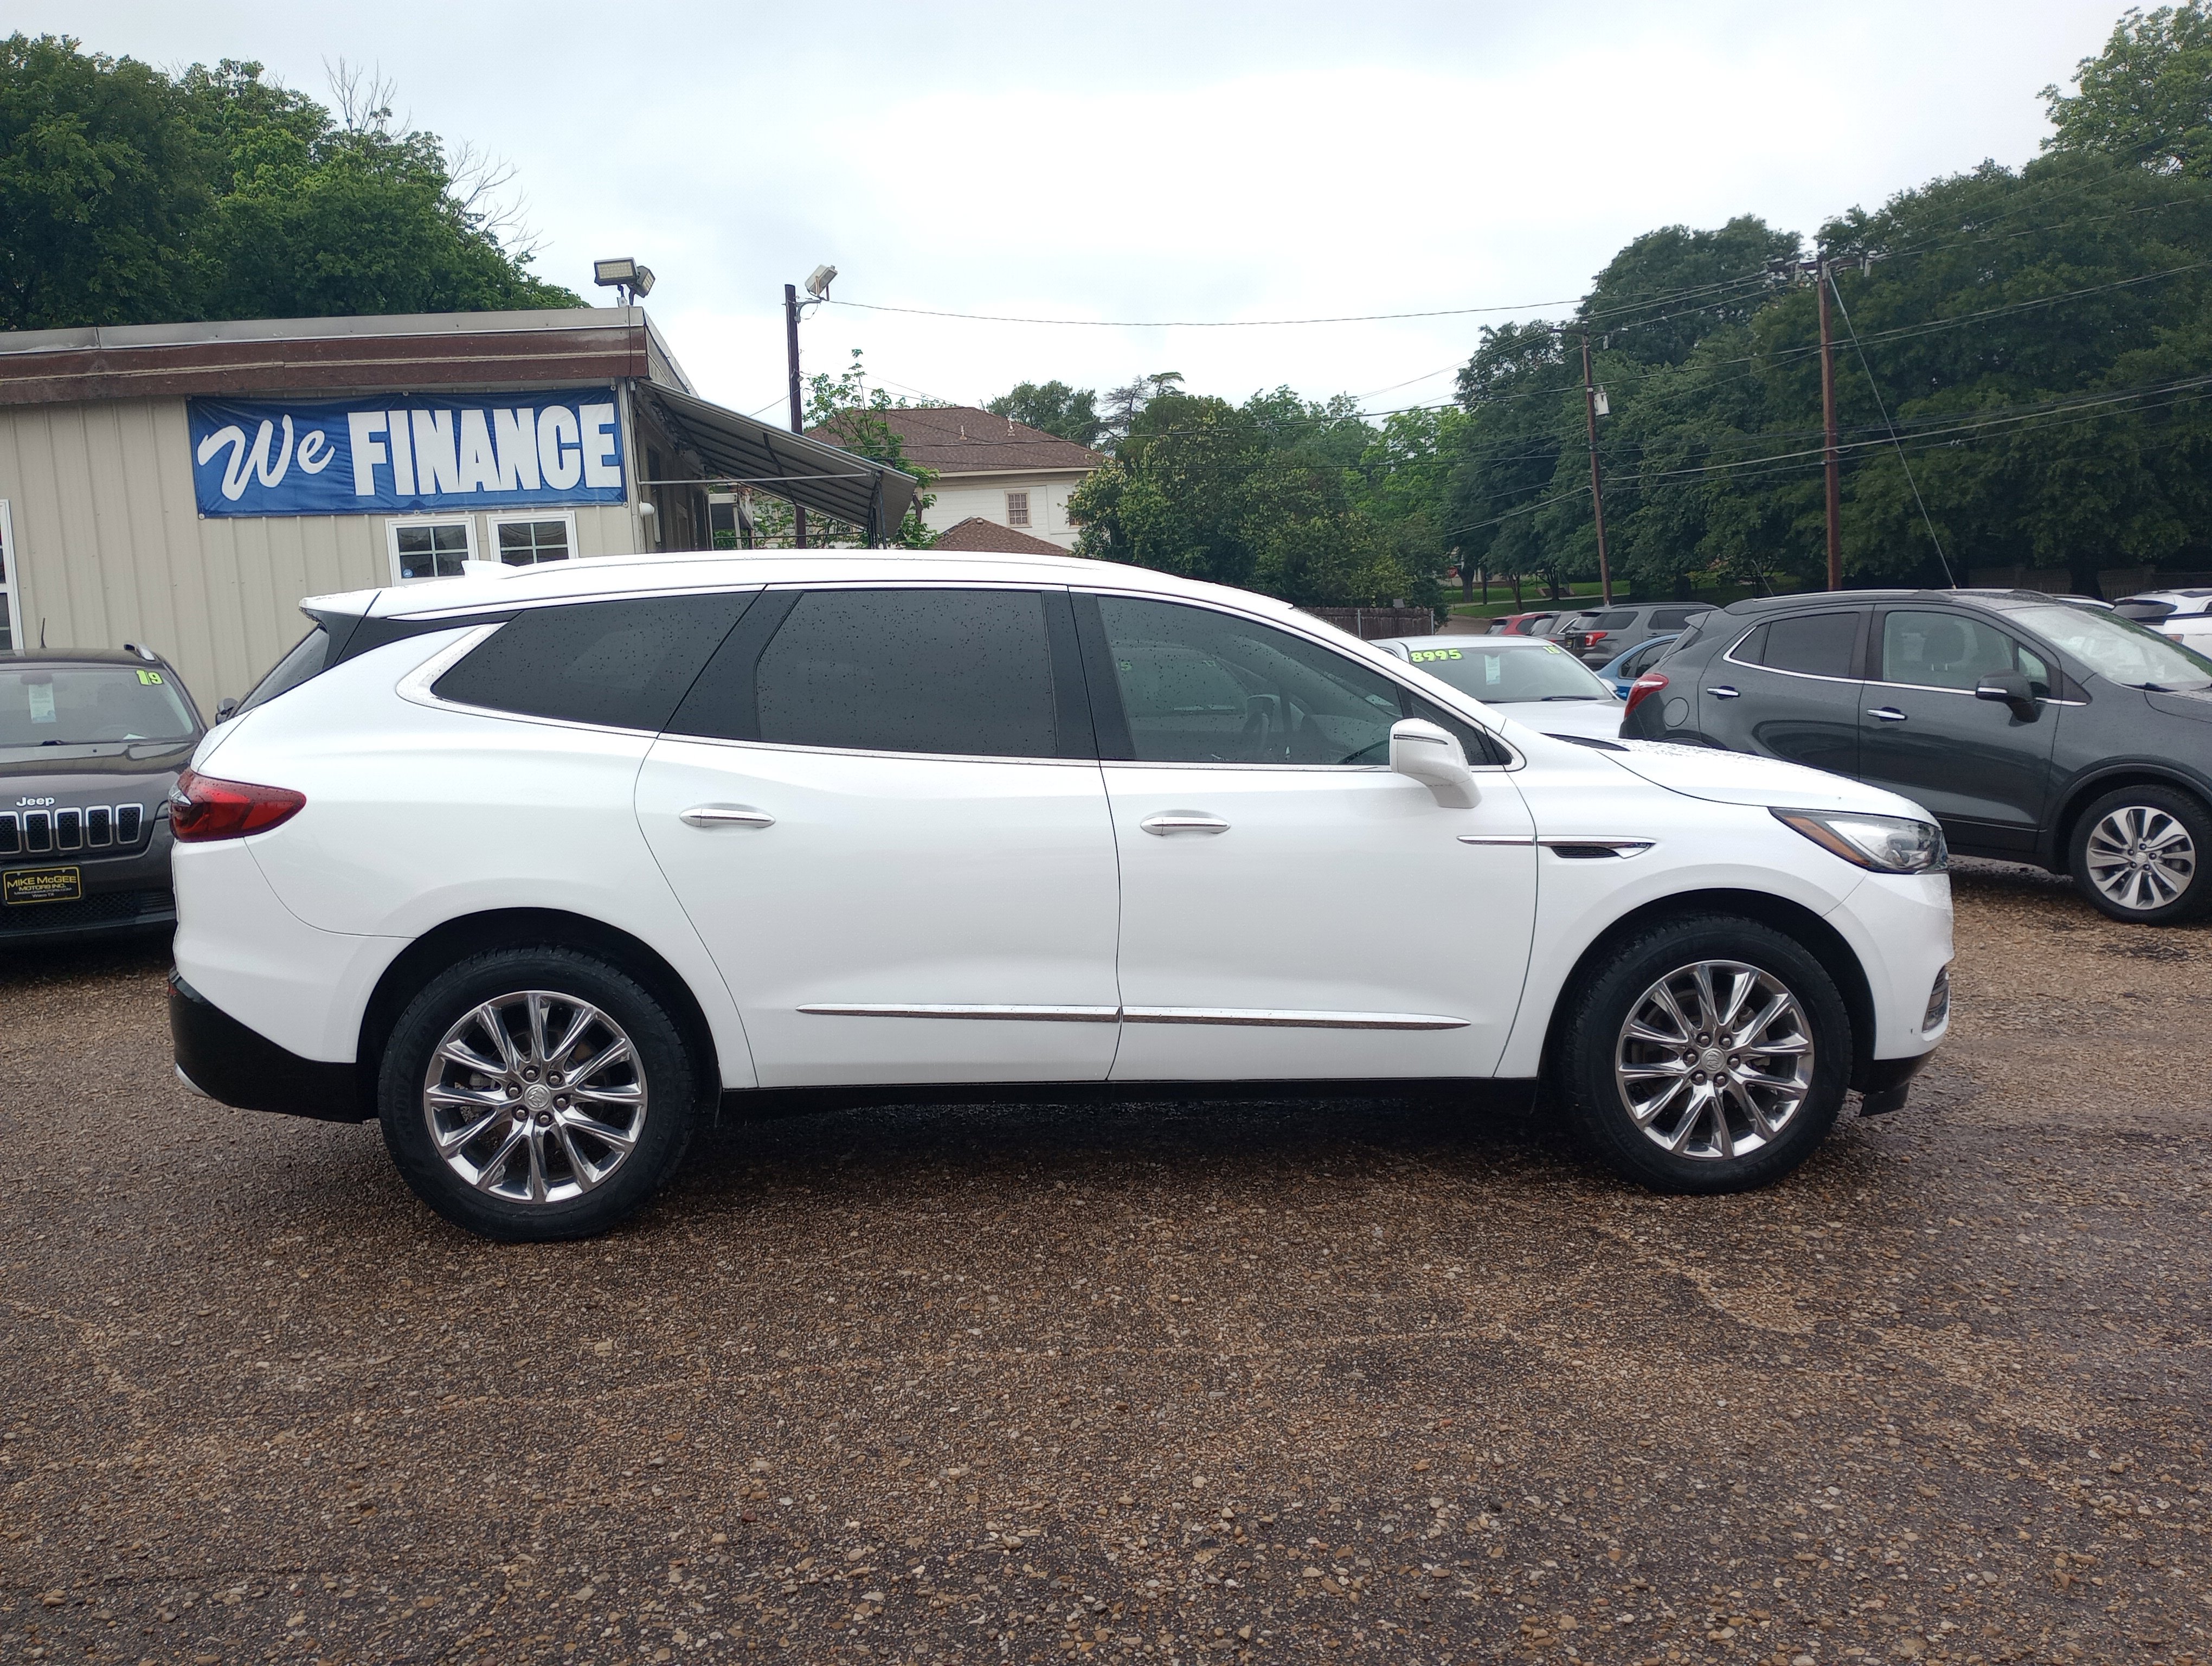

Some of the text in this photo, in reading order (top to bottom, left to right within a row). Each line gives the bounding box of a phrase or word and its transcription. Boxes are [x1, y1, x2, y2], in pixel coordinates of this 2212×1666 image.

[197, 402, 622, 501] We FINANCE
[1410, 648, 1462, 663] 8995
[136, 669, 163, 685] 19
[16, 797, 55, 806] Jeep
[7, 875, 77, 889] MIKE McGEE
